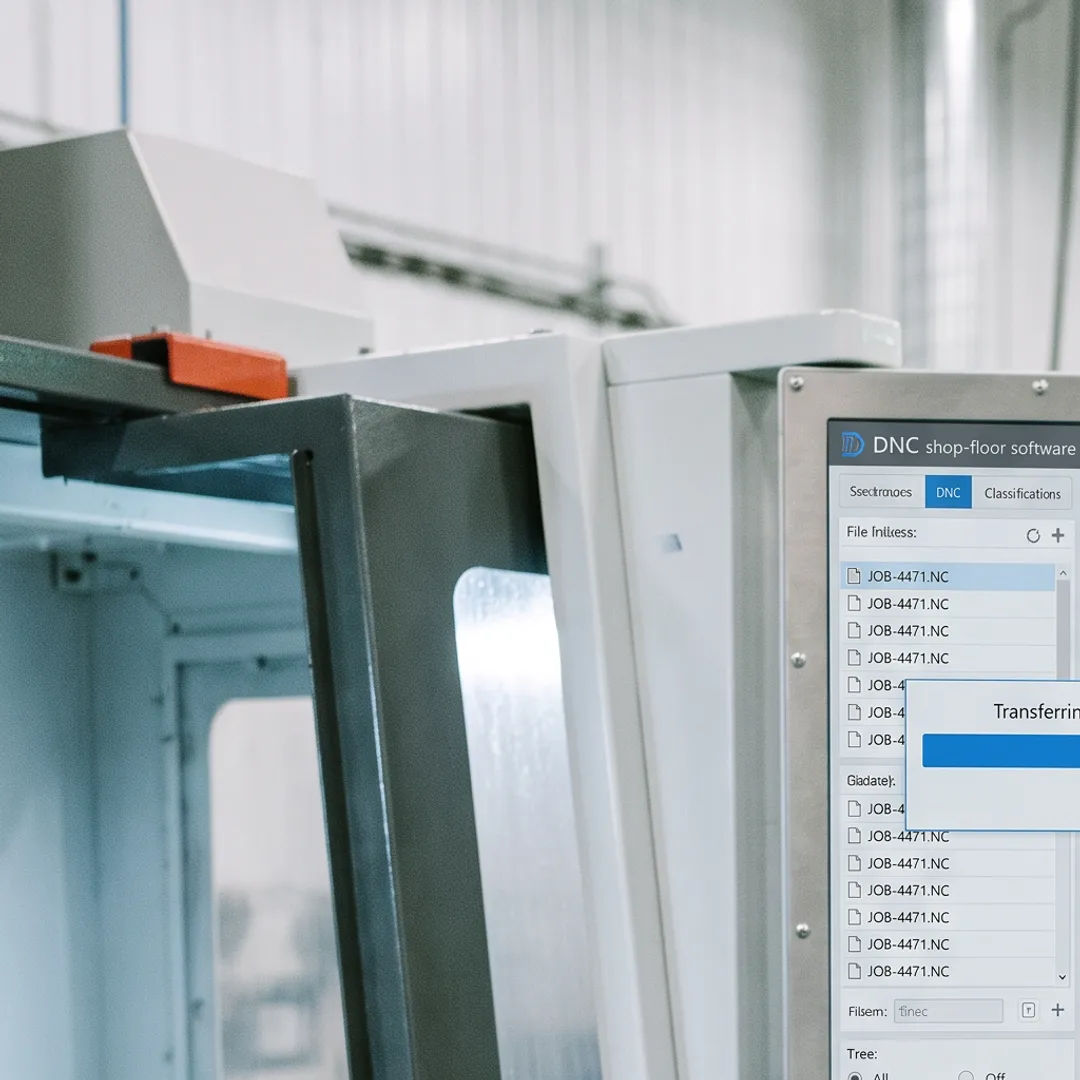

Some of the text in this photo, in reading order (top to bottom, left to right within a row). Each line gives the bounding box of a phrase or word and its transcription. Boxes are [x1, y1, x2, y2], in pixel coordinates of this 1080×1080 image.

[873, 436, 919, 454] DNC
[925, 439, 1007, 458] shop-floor
[1011, 440, 1077, 456] software
[936, 486, 961, 499] DNC
[984, 487, 1062, 500] Classifications
[847, 525, 868, 538] File
[867, 570, 949, 584] JOB-4471.NC
[867, 597, 949, 611] JOB-4471.NC
[867, 624, 949, 638] JOB-4471.NC
[867, 651, 950, 665] JOB-4471.NC
[867, 679, 904, 692] JOB-4
[867, 706, 904, 719] JOB-4
[867, 733, 904, 746] JOB-4
[867, 802, 904, 815] JOB-4
[867, 831, 950, 844] JOB-4471.NC
[867, 857, 950, 870] JOB-4471.NC
[867, 884, 950, 897] JOB-4471.NC
[867, 911, 950, 924] JOB-4471.NC
[867, 938, 950, 951] JOB-4471.NC
[867, 964, 950, 978] JOB-4471.NC
[846, 1048, 878, 1060] Tree:
